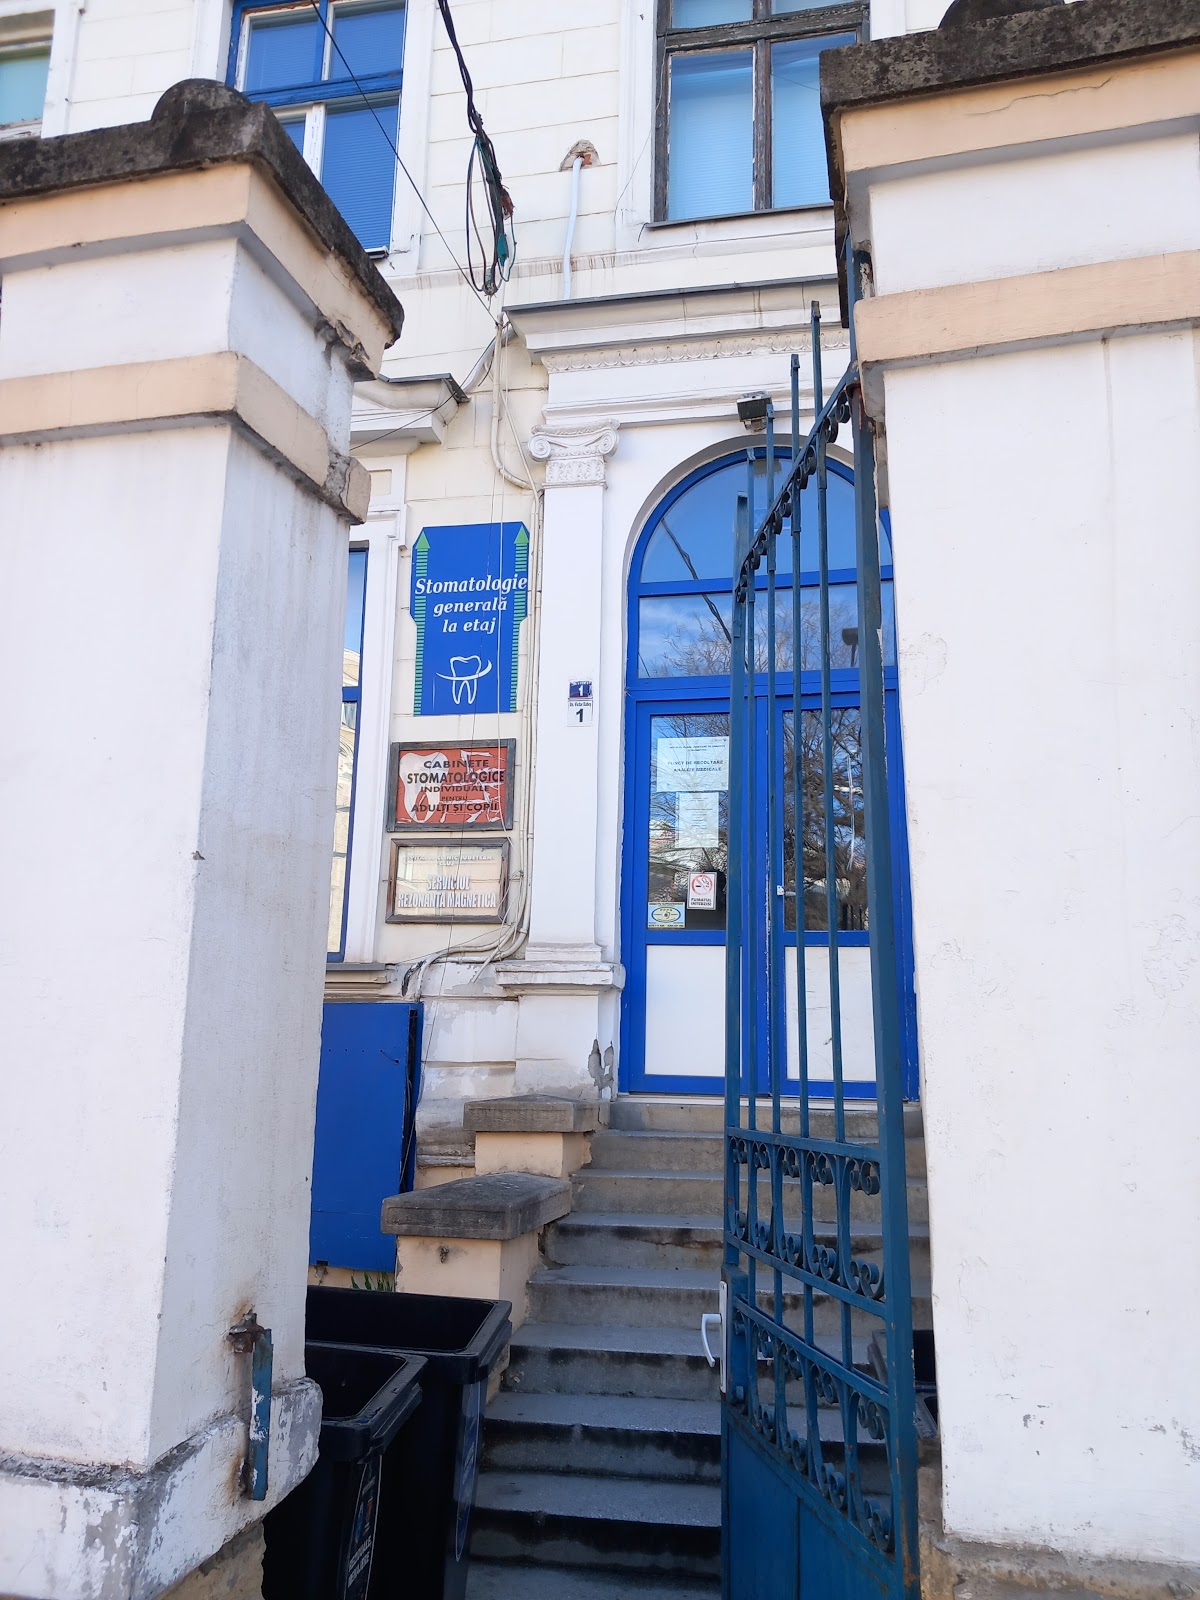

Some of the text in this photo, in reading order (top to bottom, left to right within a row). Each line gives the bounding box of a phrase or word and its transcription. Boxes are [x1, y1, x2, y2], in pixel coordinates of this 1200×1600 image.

[415, 573, 528, 594] Stomatologie
[433, 597, 508, 617] generală
[442, 617, 497, 635] la etaj
[578, 684, 584, 697] 1
[575, 708, 584, 723] 1
[423, 759, 489, 769] CABINETE
[407, 771, 505, 784] STOMATOLOGICE
[420, 785, 490, 793] INDIVIDUALE
[427, 876, 471, 891] SERVICIUL
